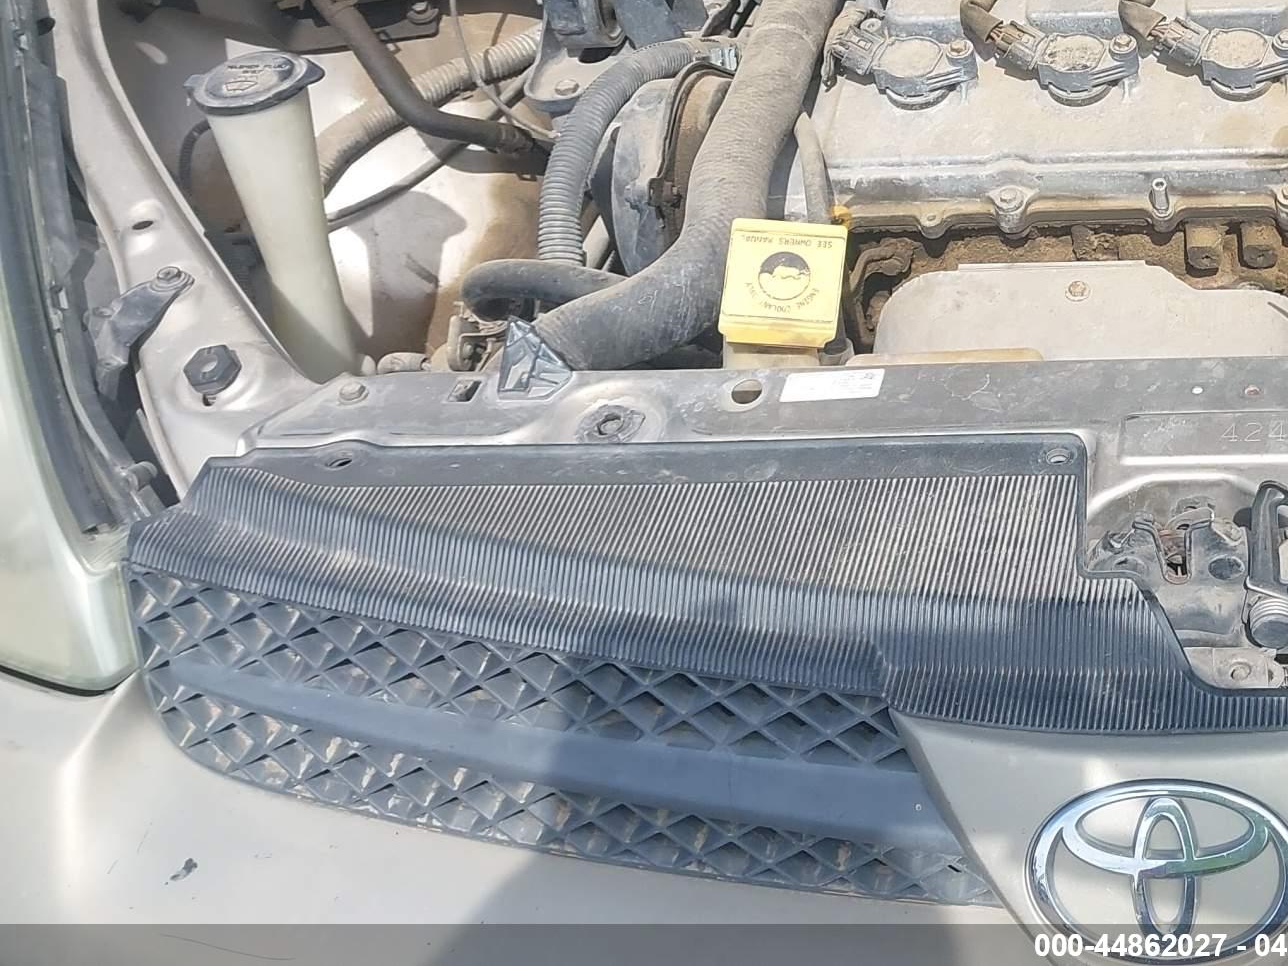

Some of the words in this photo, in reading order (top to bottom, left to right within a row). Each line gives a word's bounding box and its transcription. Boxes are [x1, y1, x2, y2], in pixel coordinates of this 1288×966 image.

[779, 236, 812, 247] OWNERS
[817, 240, 833, 249] SEE
[795, 287, 820, 309] ENGINE
